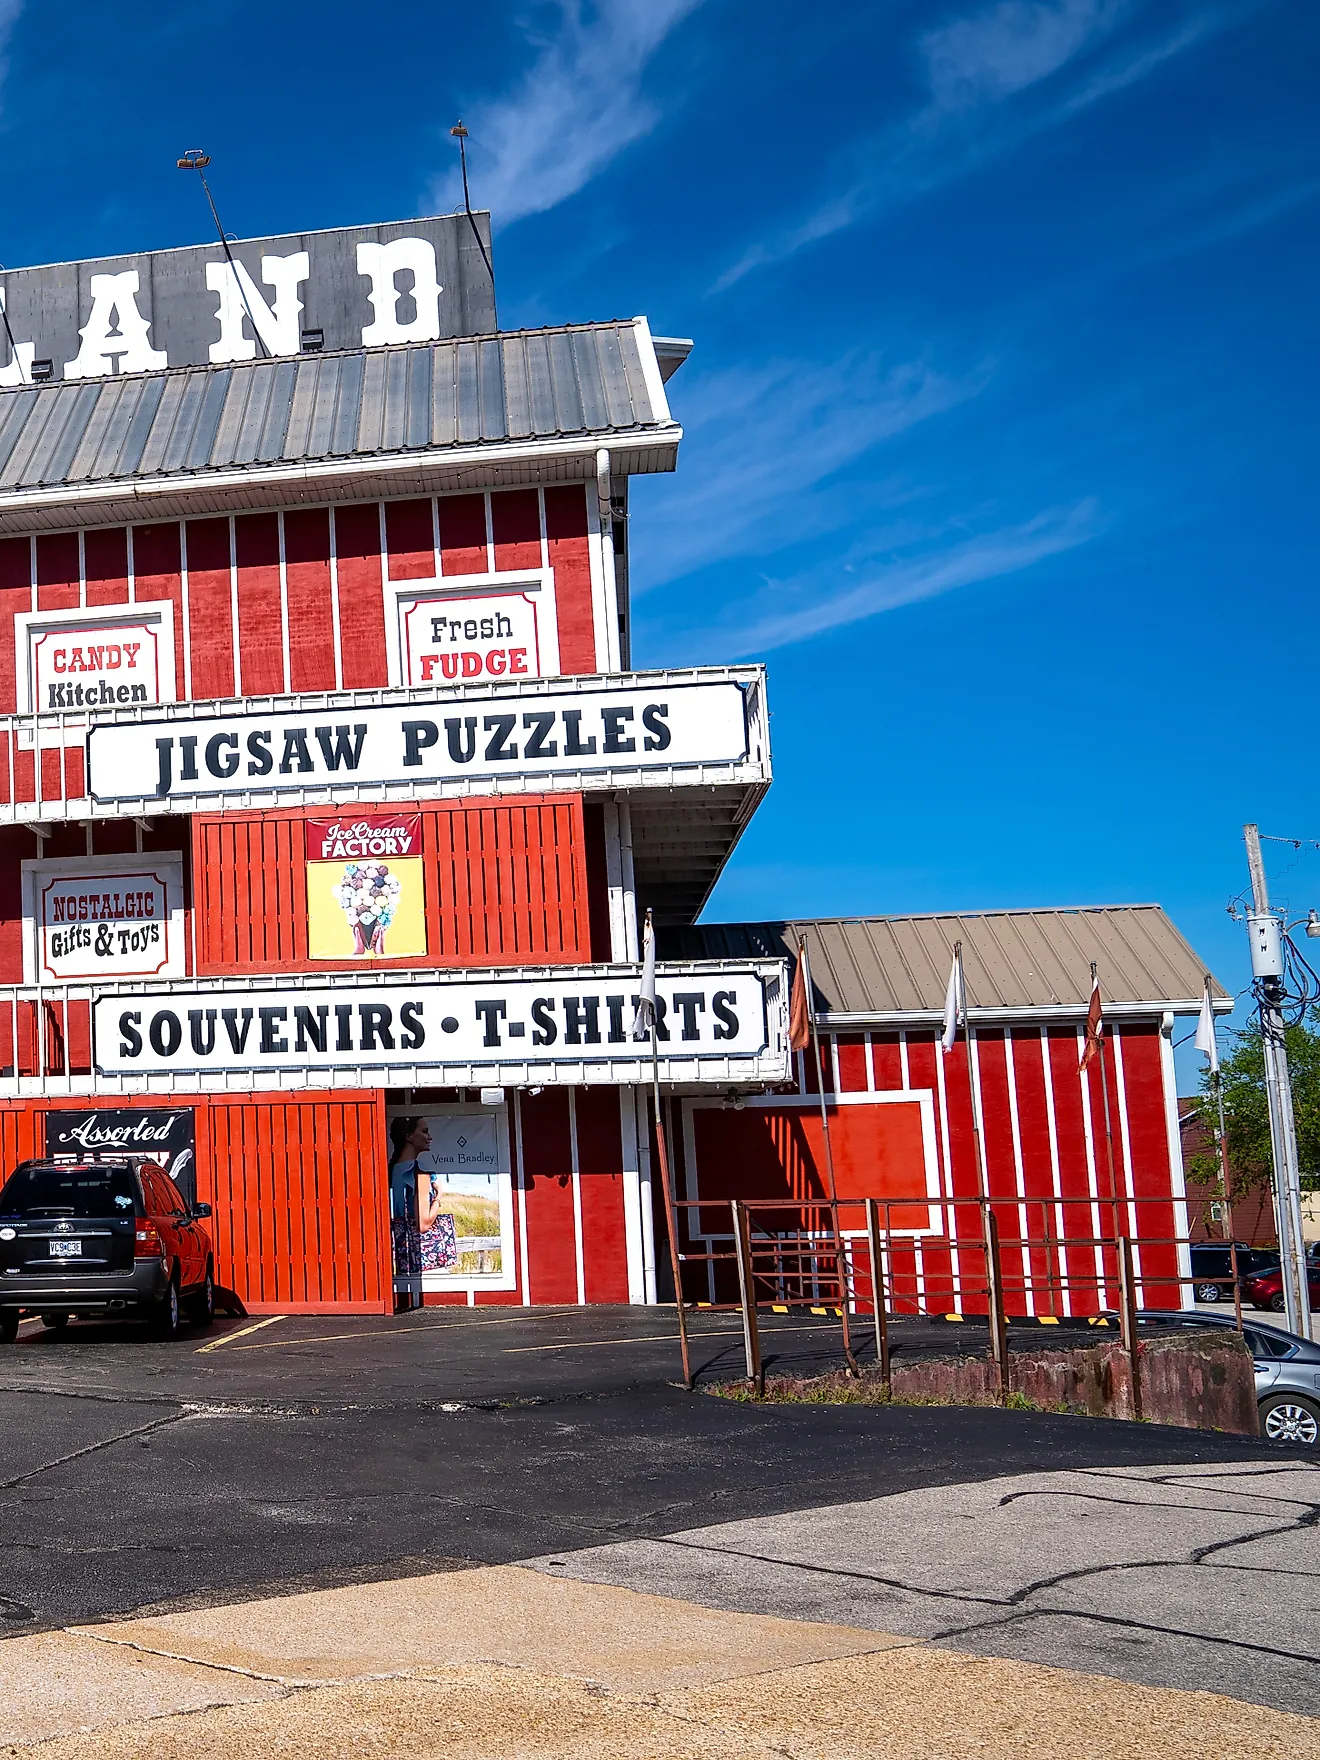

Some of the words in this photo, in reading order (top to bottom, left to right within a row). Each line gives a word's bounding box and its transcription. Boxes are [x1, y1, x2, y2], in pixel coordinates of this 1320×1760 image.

[431, 612, 513, 643] Fresh
[53, 643, 140, 673] CANDY
[420, 648, 528, 680] FUDGE
[48, 680, 147, 708] Kitchen
[155, 723, 368, 797] JIGSAW
[401, 703, 671, 767] PUZZLES
[321, 836, 412, 858] FACTORY
[53, 891, 154, 921] NOSTALGIC
[51, 926, 91, 958] Gifts
[94, 923, 114, 957] &
[118, 923, 159, 954] Toys
[119, 1001, 425, 1057] SOUVENIRS
[475, 990, 740, 1048] T-SHIRTS
[58, 1114, 175, 1148] Assorted
[432, 1154, 454, 1165] Vera
[458, 1151, 495, 1165] Bradley
